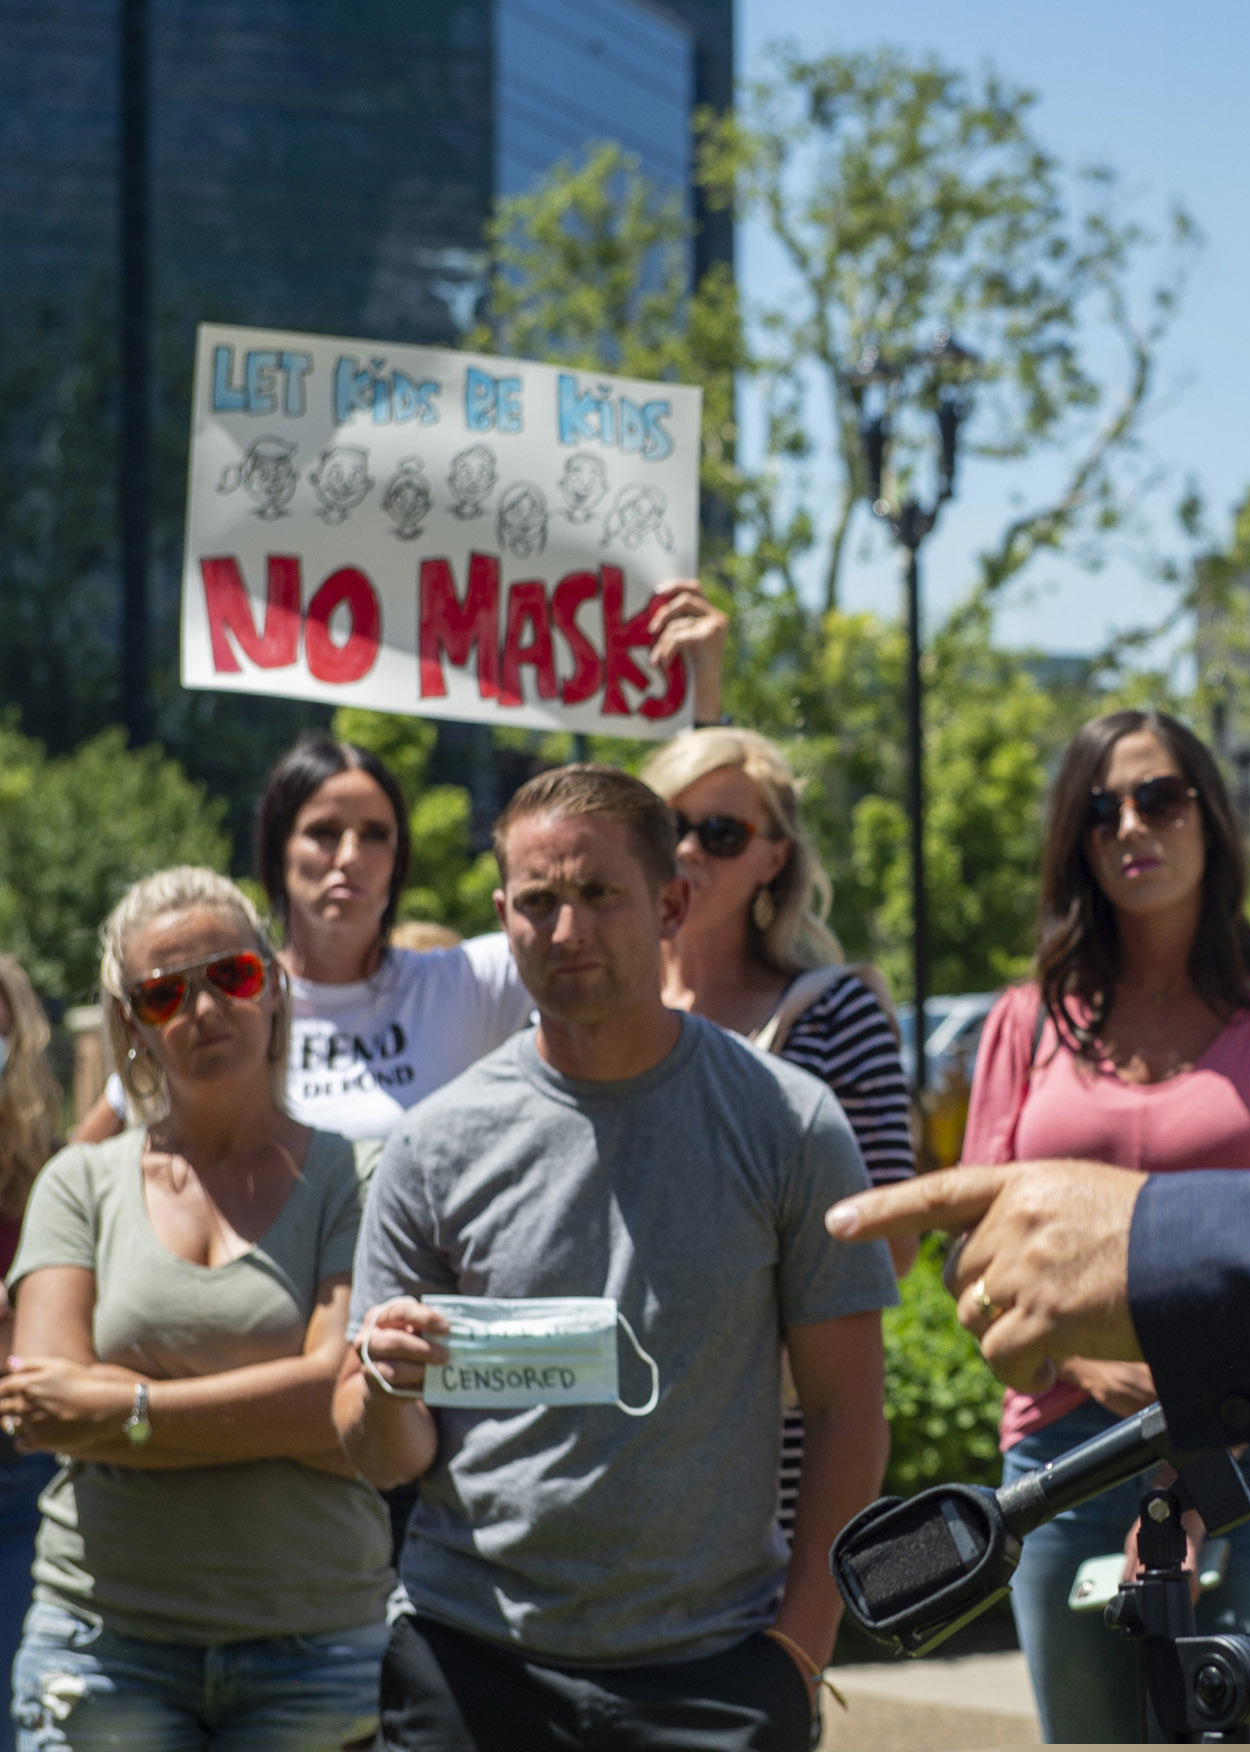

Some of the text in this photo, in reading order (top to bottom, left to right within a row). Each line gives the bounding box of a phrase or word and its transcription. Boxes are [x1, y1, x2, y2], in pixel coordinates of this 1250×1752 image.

[211, 344, 313, 417] LET
[464, 365, 524, 434] BE
[200, 555, 381, 684] NO
[441, 1365, 577, 1392] CENSORED
